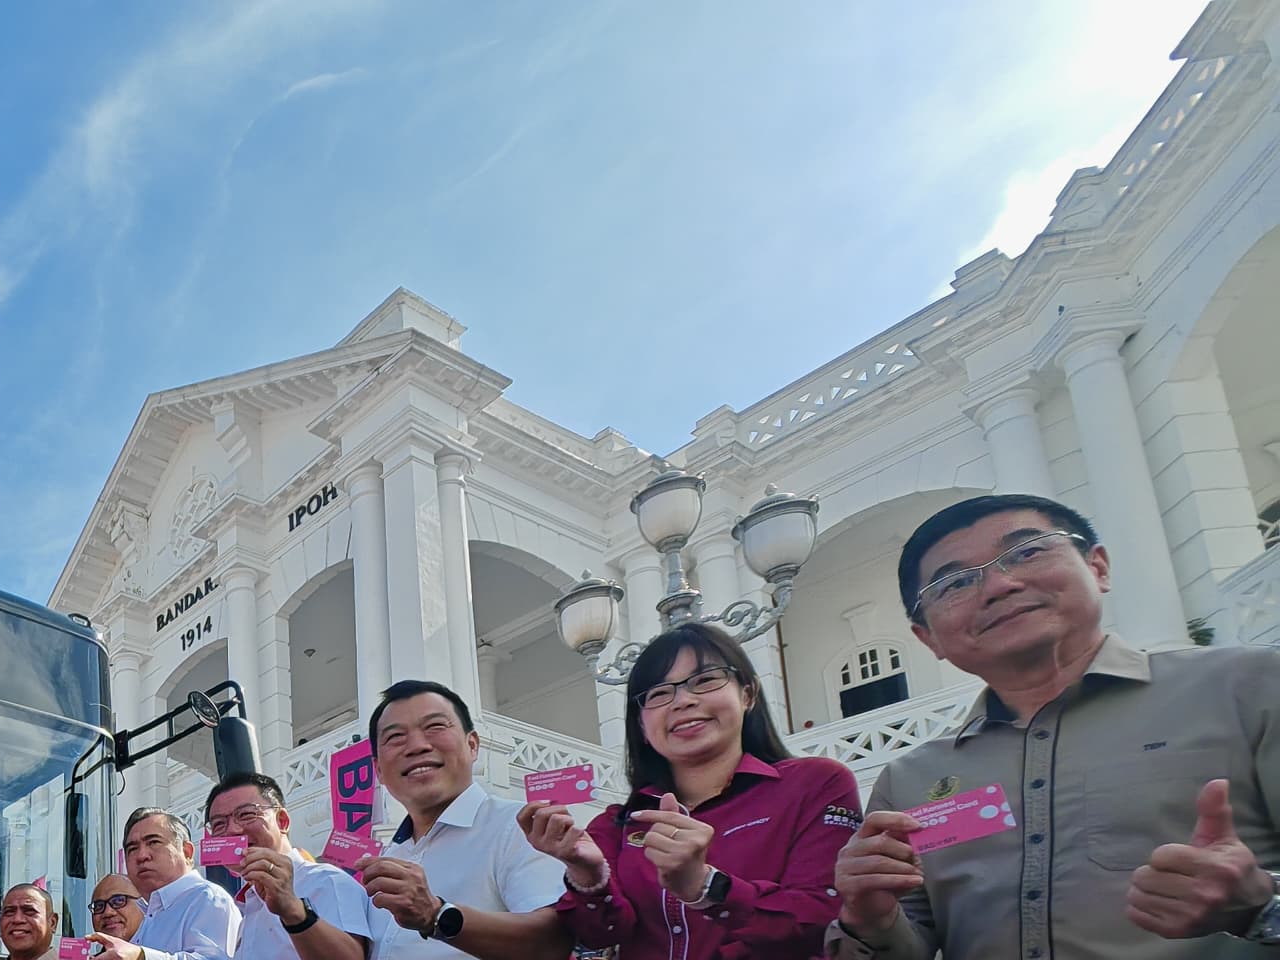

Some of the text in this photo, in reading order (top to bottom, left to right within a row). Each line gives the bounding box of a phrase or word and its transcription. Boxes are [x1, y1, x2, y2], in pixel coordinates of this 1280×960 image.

[288, 481, 339, 532] IPOH
[180, 615, 213, 651] 1914
[337, 755, 374, 876] BA
